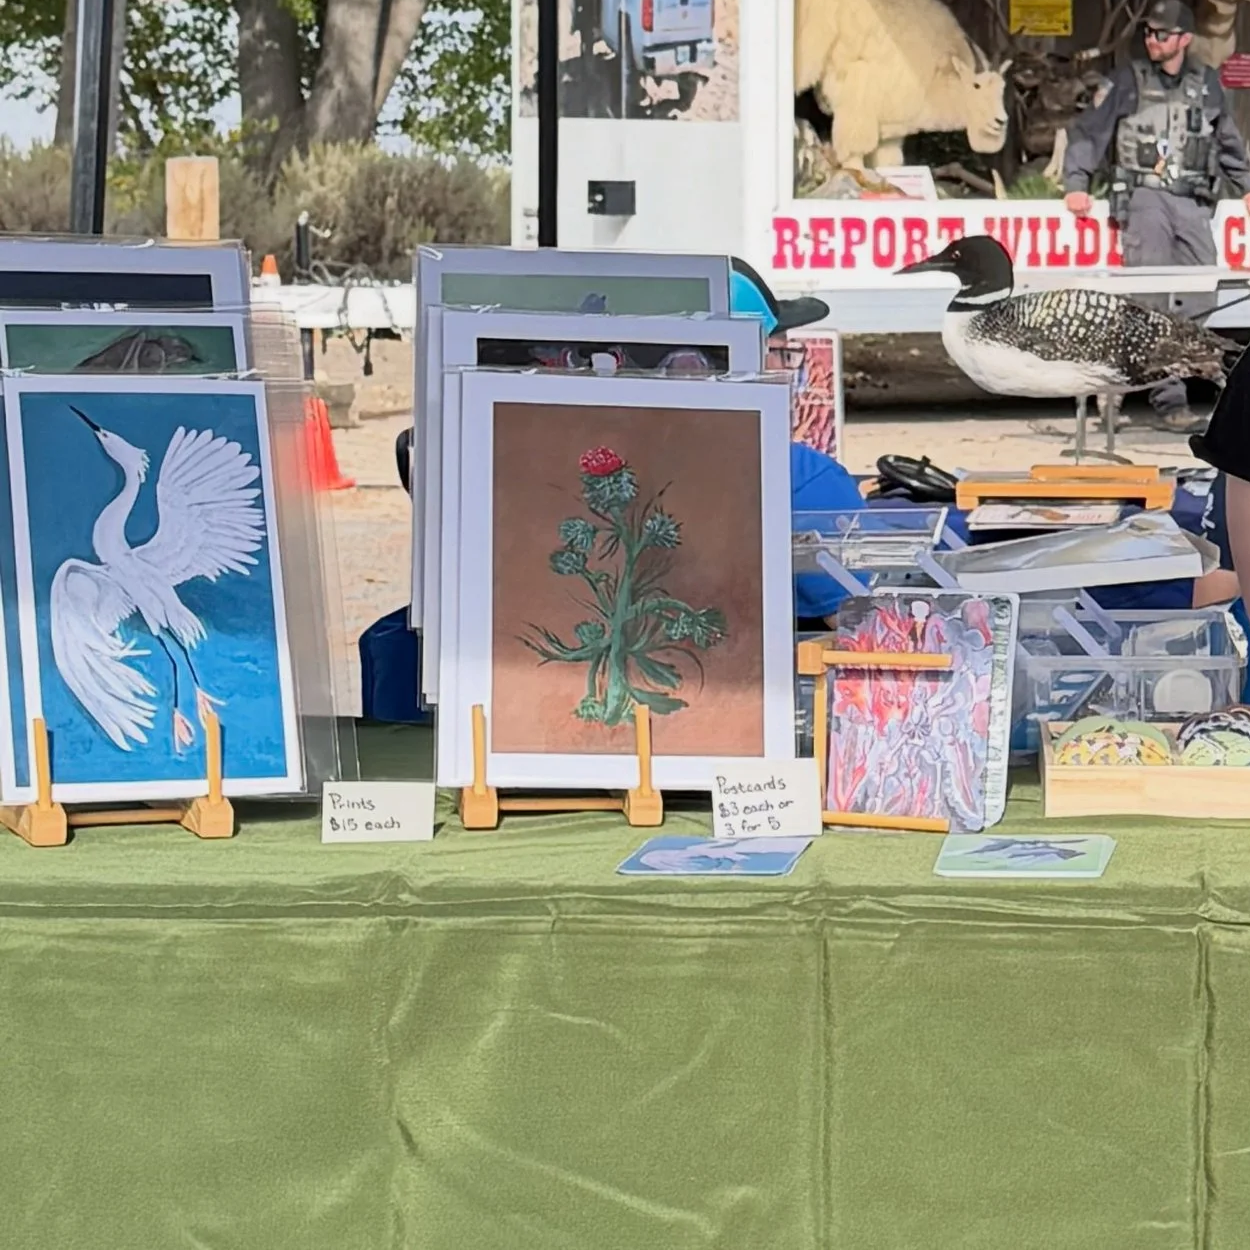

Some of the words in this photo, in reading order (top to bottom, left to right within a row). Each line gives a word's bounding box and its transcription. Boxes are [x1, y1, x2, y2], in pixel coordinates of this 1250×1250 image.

[716, 775, 787, 795] Postcards
[328, 792, 376, 811] Prints
[742, 799, 774, 815] each
[778, 800, 794, 810] or
[329, 816, 358, 832] $15
[364, 815, 401, 831] each
[724, 822, 736, 836] 3
[741, 819, 762, 832] for
[767, 816, 781, 831] 5
